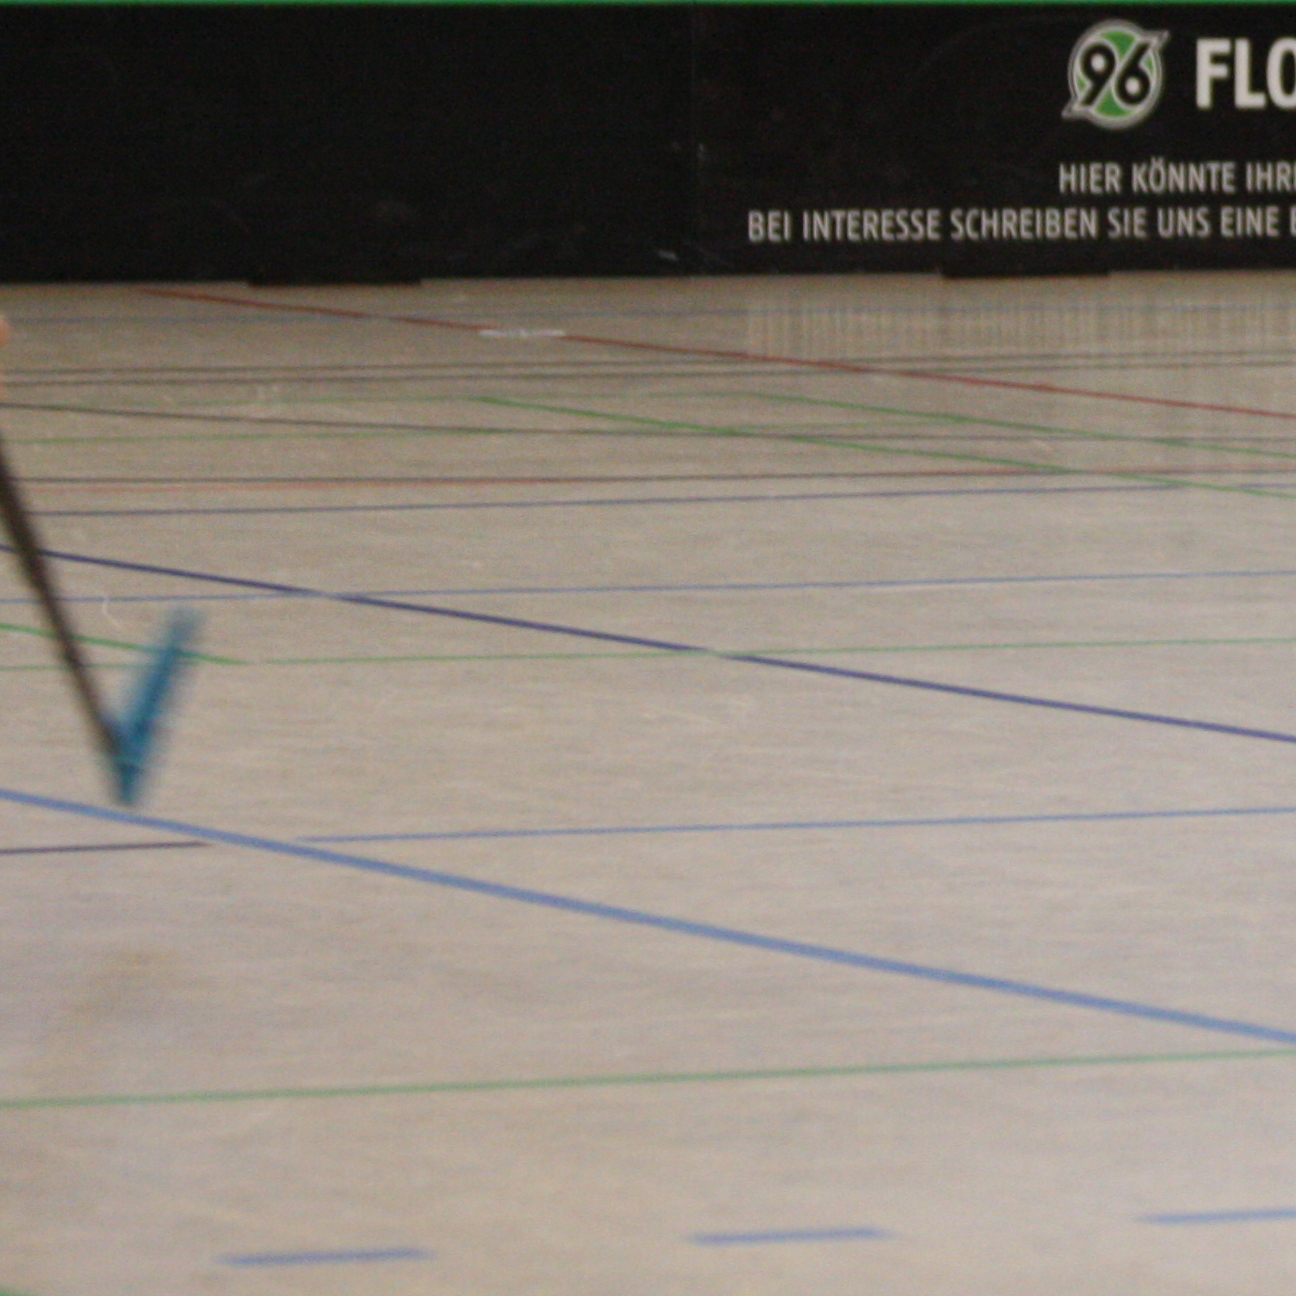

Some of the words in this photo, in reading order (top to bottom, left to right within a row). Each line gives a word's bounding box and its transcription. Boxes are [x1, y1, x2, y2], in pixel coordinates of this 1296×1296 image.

[1058, 161, 1122, 195] HIER
[1131, 157, 1237, 194] KÖNNTE
[747, 209, 792, 243] BEI
[802, 208, 942, 243] INTERESSE
[949, 206, 1098, 242] SCHREIBEN
[1107, 206, 1149, 240] SIE
[1157, 205, 1211, 238] UNS
[1219, 205, 1280, 237] EINE
